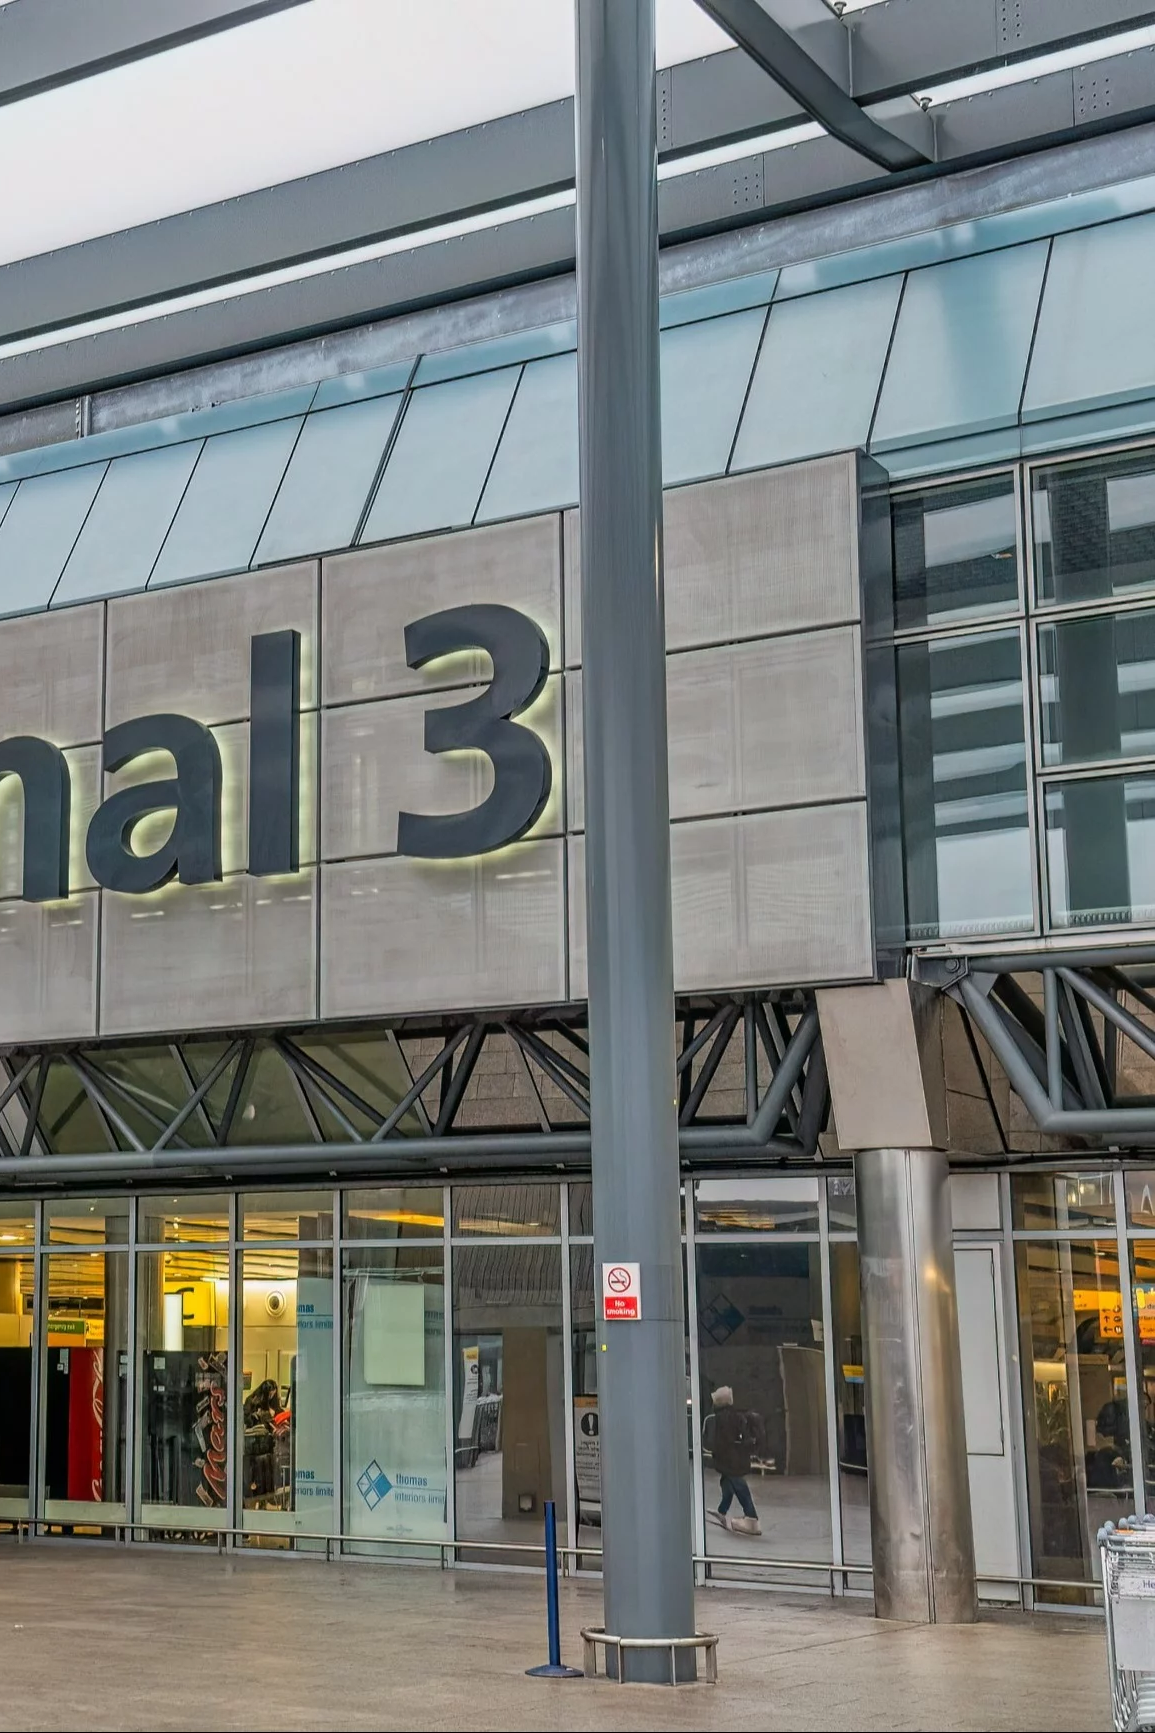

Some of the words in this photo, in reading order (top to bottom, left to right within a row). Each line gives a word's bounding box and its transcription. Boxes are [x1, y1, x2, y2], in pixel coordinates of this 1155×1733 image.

[397, 603, 553, 860] 3
[606, 1307, 636, 1316] smoking
[396, 1474, 428, 1487] thomas
[394, 1492, 426, 1504] interiors
